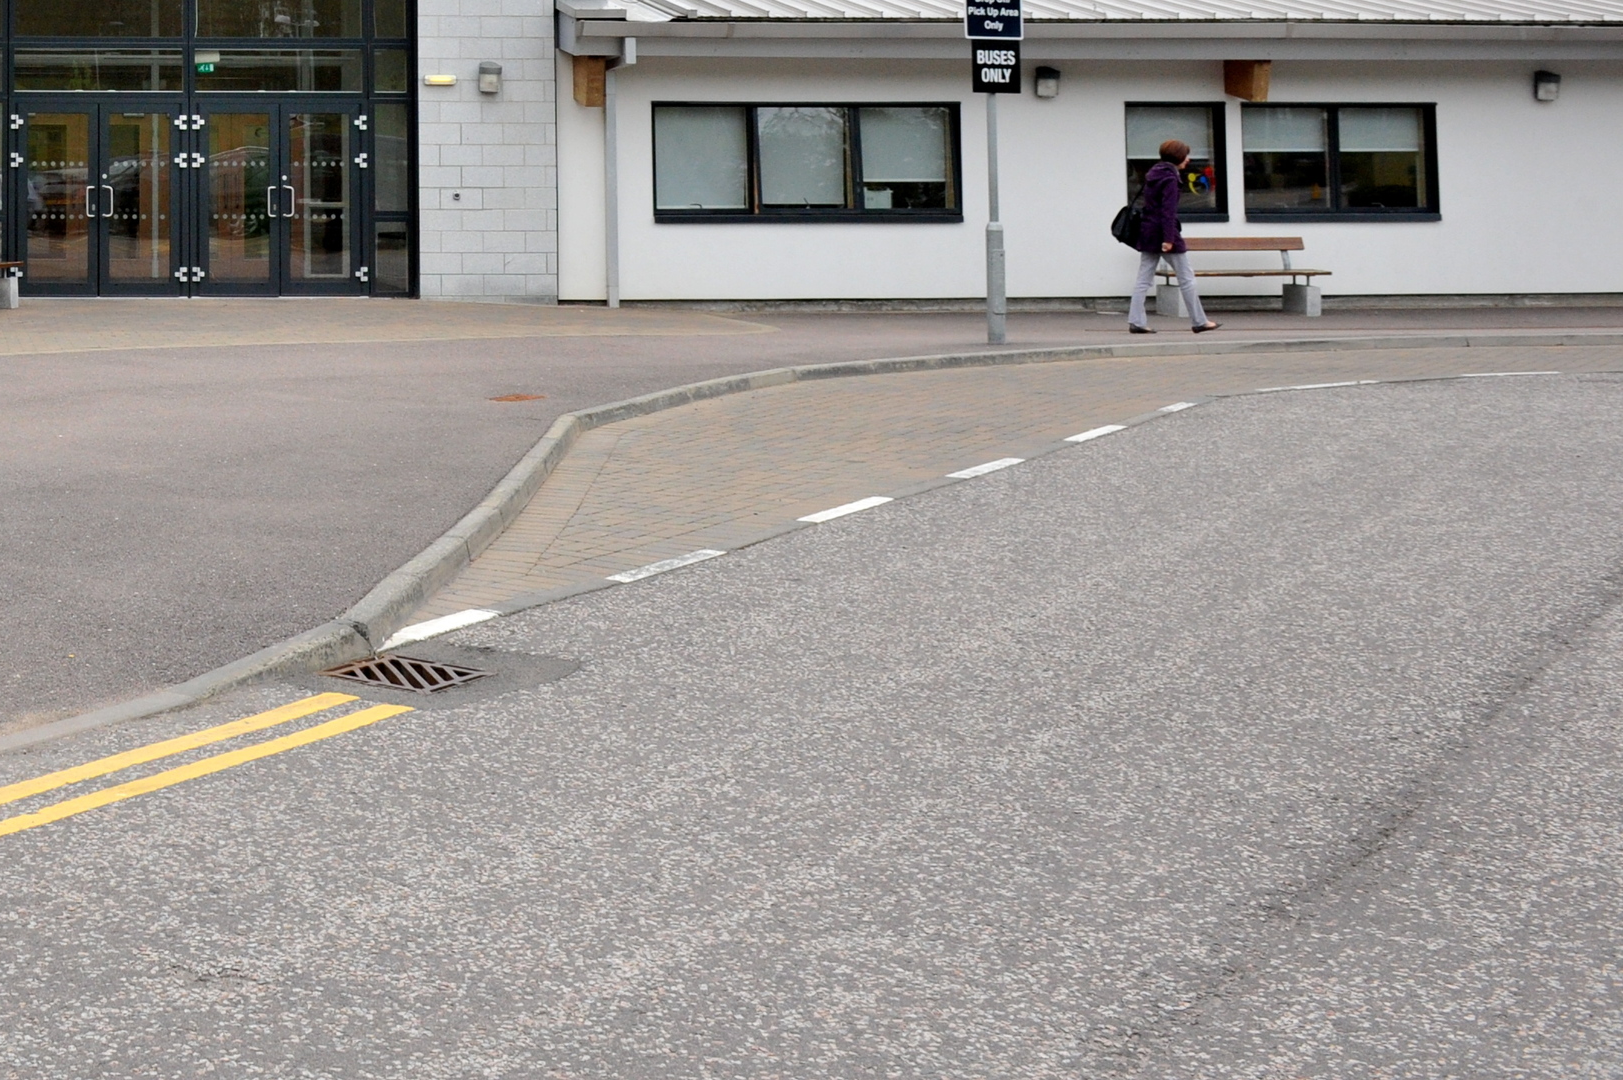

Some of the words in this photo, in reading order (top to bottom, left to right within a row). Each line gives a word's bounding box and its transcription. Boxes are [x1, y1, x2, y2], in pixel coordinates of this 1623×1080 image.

[968, 6, 986, 16] Pick
[986, 7, 999, 18] Up
[999, 7, 1019, 17] Area
[984, 20, 1004, 32] Only
[976, 49, 1016, 66] BUSES
[981, 67, 1012, 84] ONLY
